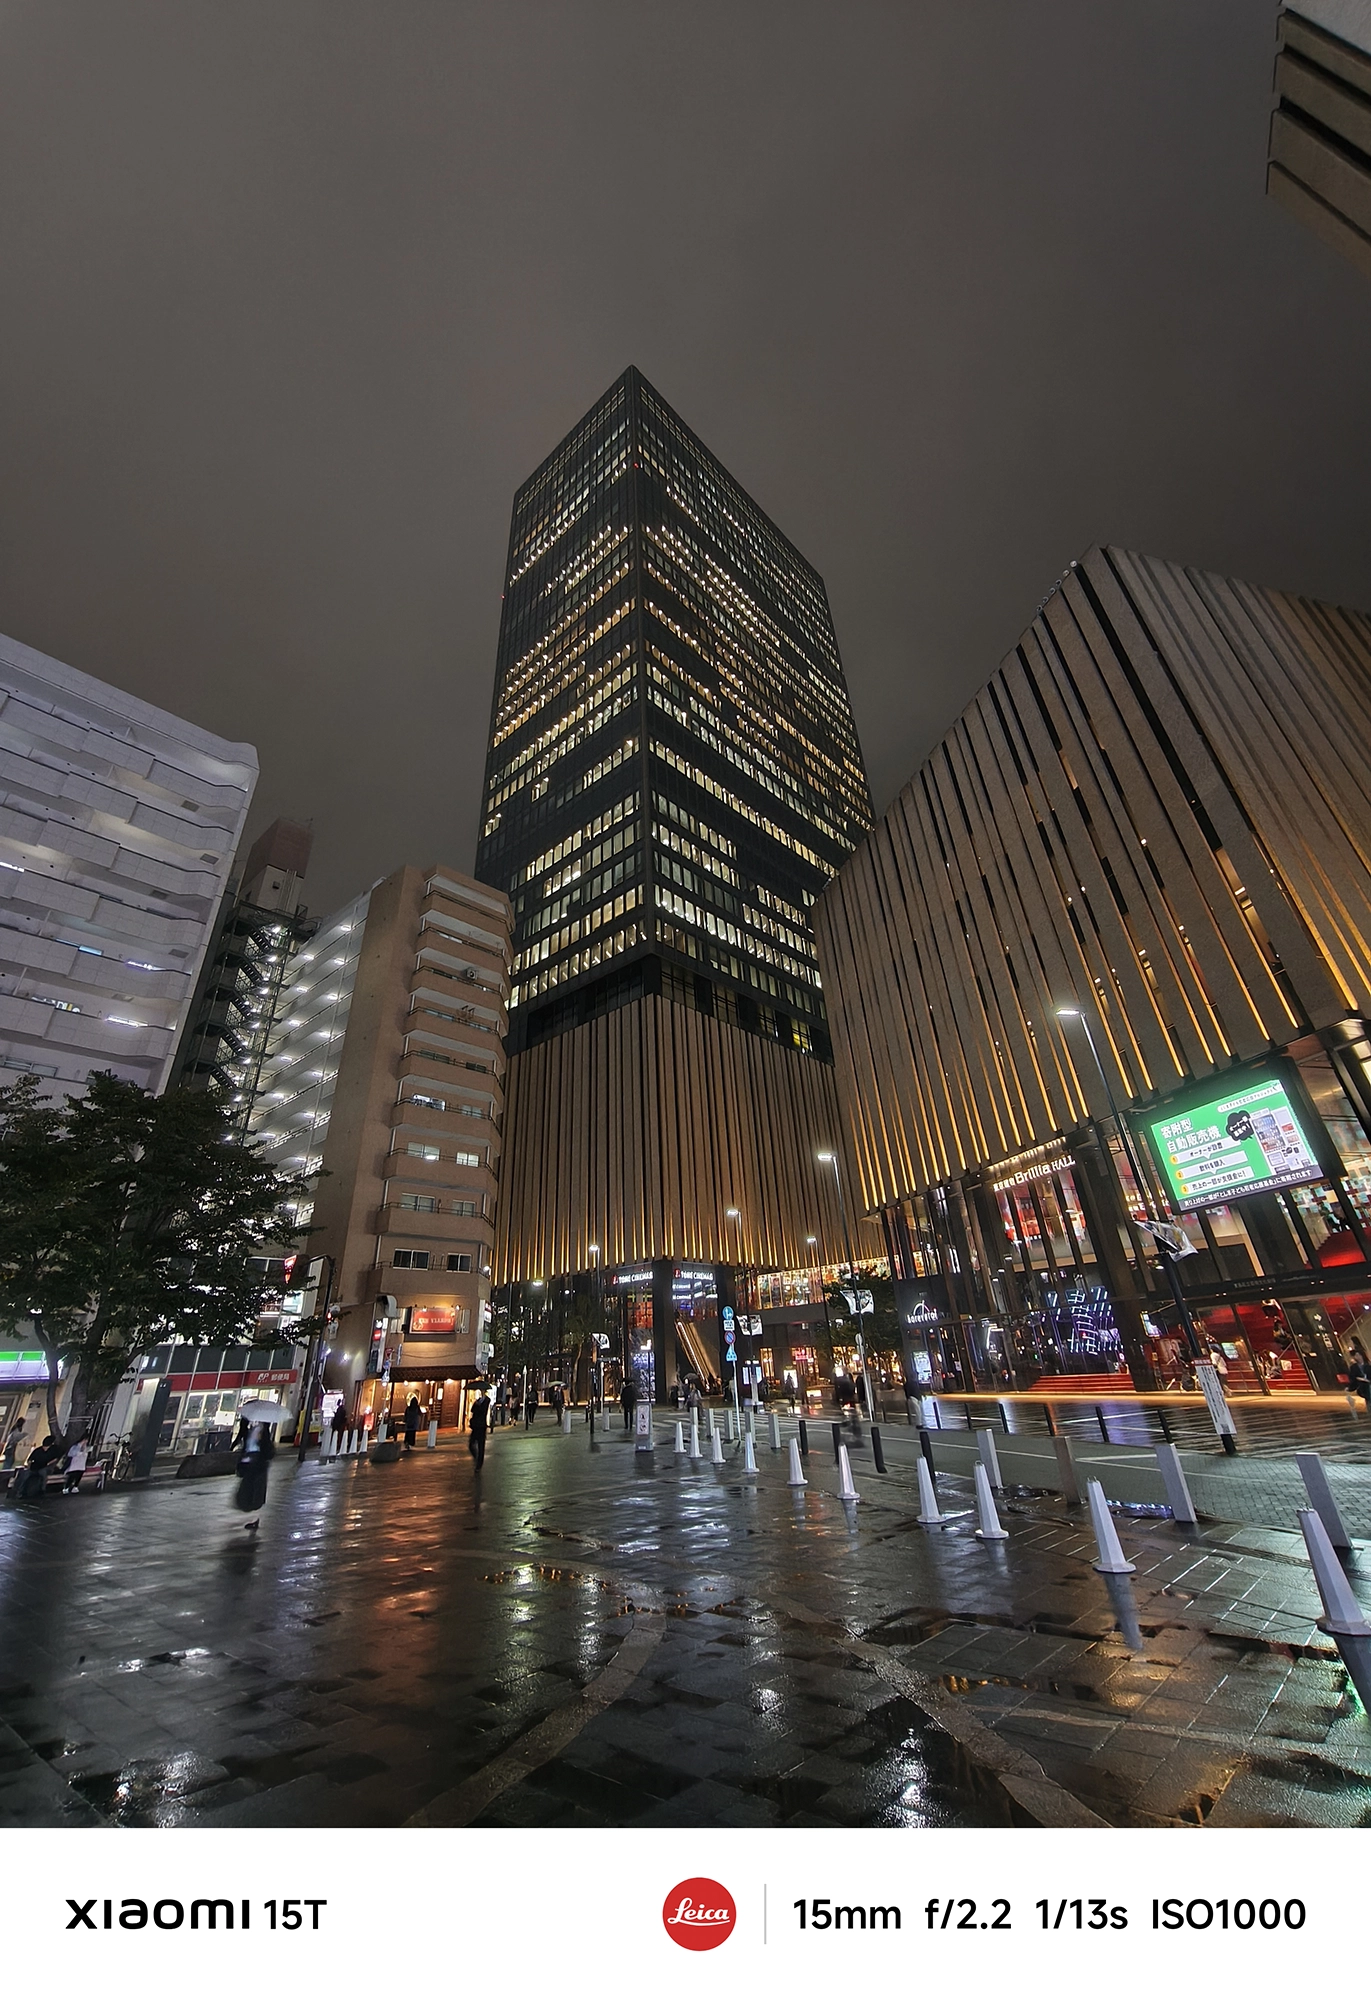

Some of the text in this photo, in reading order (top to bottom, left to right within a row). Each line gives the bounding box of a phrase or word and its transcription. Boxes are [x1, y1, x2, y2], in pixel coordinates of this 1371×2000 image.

[1160, 1118, 1194, 1137] 寄附型
[1166, 1126, 1222, 1153] 自動販売機
[1014, 1163, 1052, 1184] Brillia
[1051, 1154, 1076, 1173] HALL
